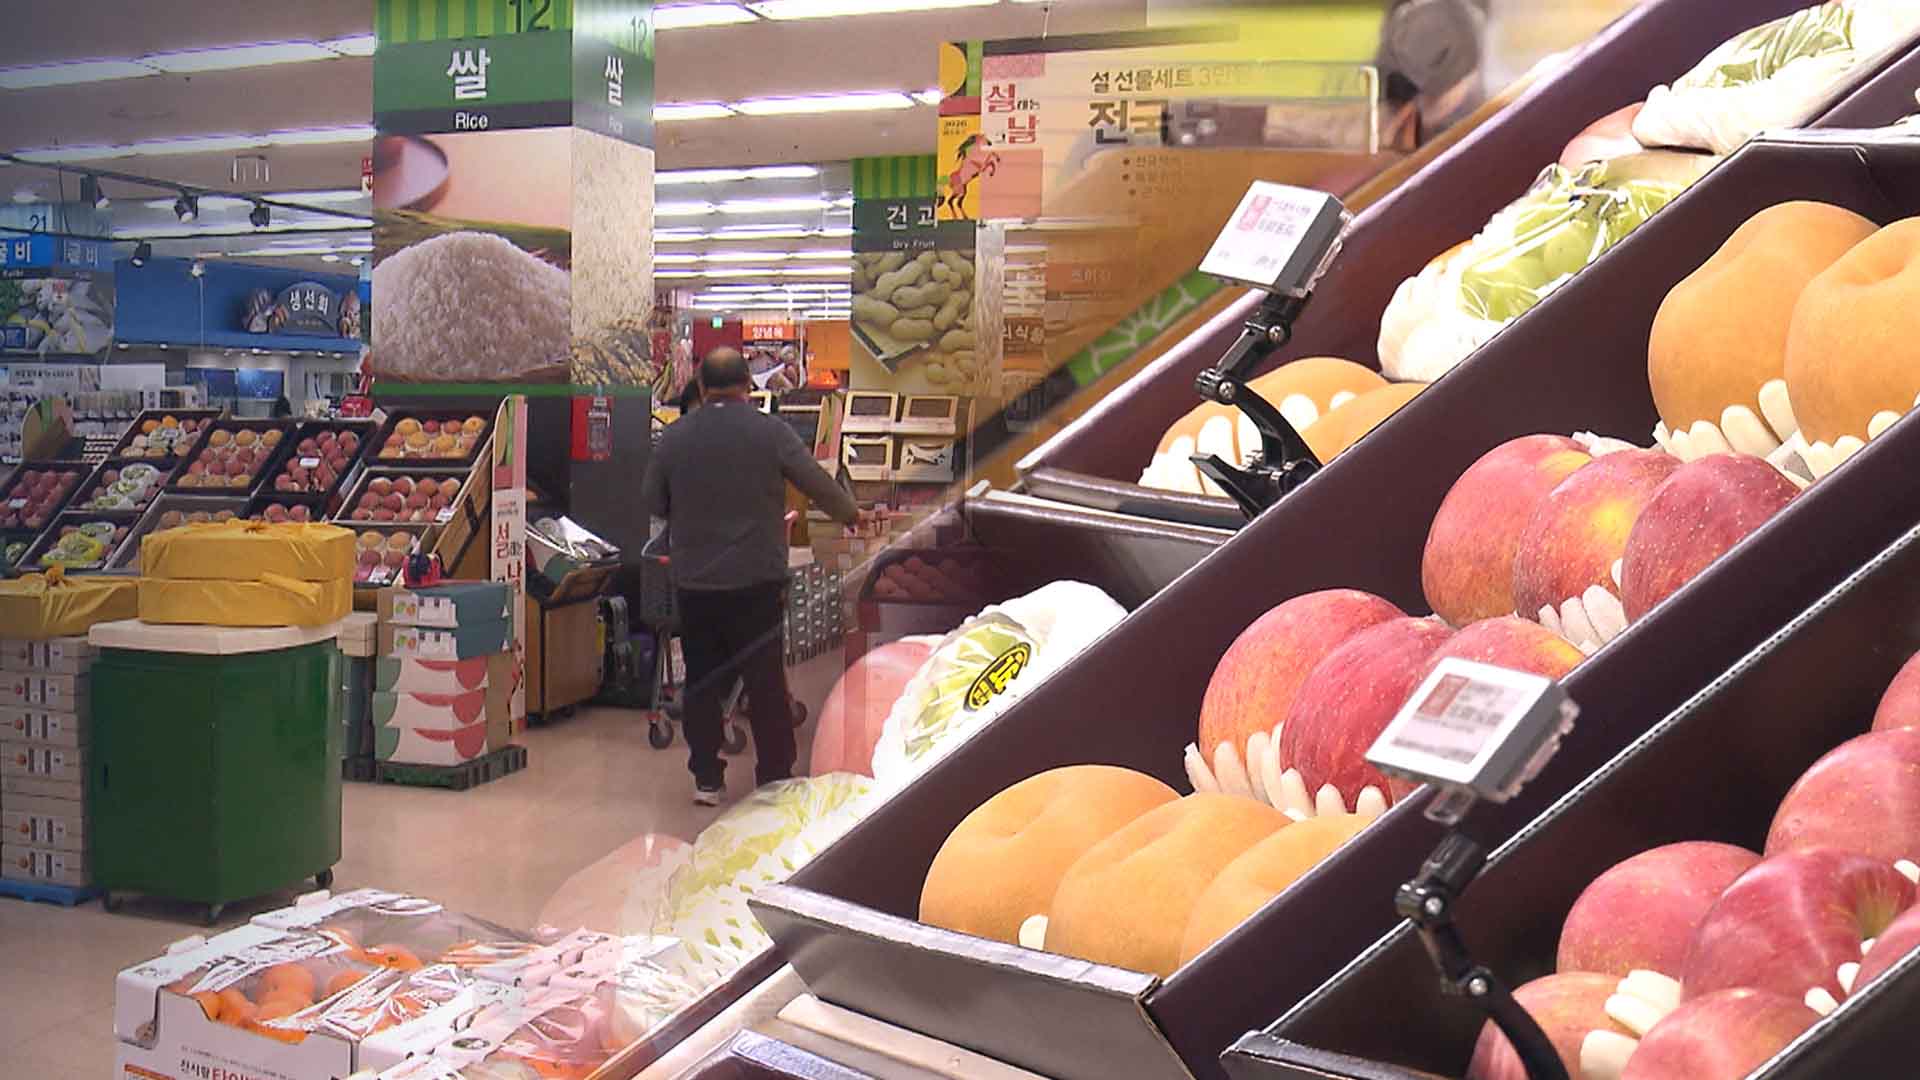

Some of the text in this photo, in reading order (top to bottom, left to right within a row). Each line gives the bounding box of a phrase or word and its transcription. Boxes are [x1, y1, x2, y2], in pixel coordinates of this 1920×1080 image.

[508, 0, 551, 33] 12
[446, 47, 492, 100] 쌀
[604, 55, 624, 107] 쌀
[1091, 71, 1110, 93] 설
[455, 112, 488, 130] Rice
[30, 214, 47, 232] 21
